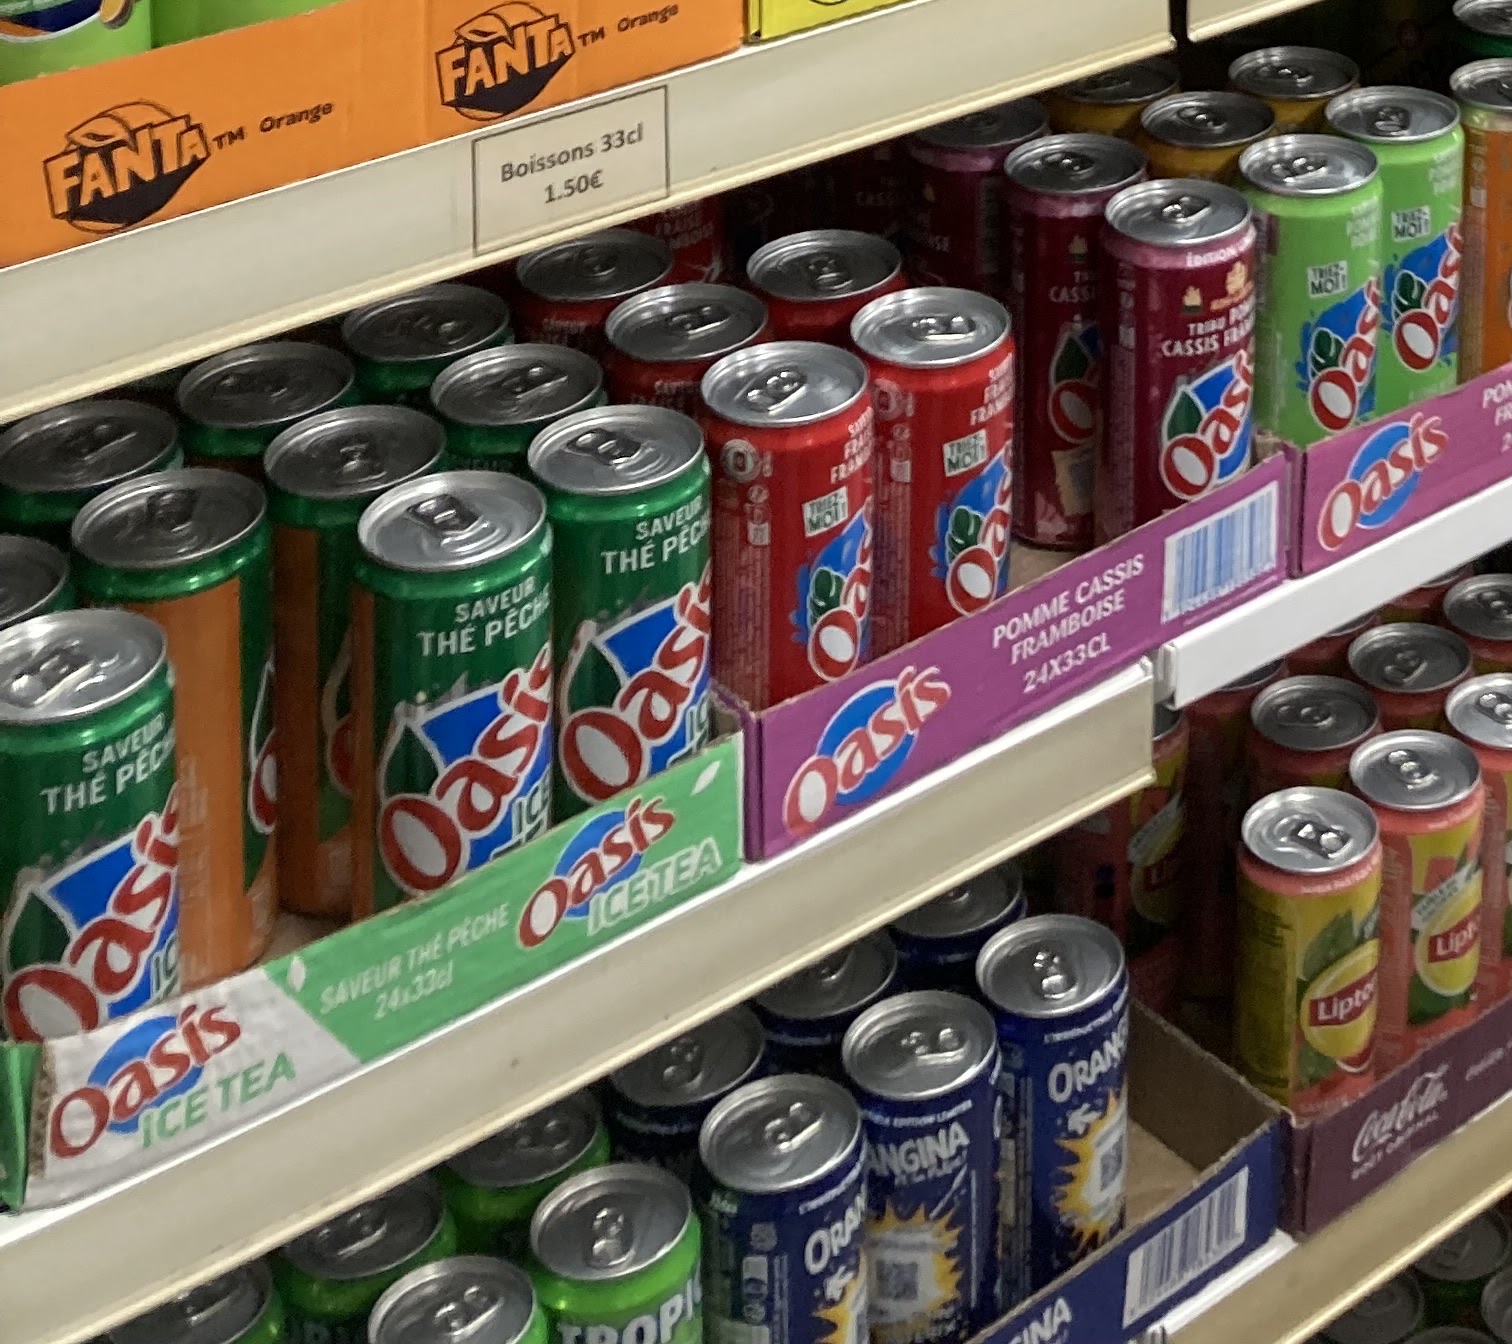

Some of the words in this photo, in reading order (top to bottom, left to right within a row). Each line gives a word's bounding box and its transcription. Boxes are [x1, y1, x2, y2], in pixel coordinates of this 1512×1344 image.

[435, 13, 577, 106] FANTA
[616, 0, 680, 33] Orange
[44, 116, 211, 220] FANTA
[259, 100, 335, 135] Orange
[500, 140, 595, 184] Boissons
[601, 122, 646, 155] 33cl
[543, 169, 606, 206] 1.50€
[1161, 337, 1220, 358] CASSIS
[1317, 411, 1450, 552] Oasis
[635, 494, 704, 542] SAVEUR
[601, 540, 655, 575] THÉ
[454, 575, 537, 625] SAVEUR
[991, 588, 1070, 649] POMME
[1075, 554, 1145, 604] CASSIS
[1010, 591, 1126, 666] FRAMBOISE
[417, 618, 477, 657] THÉ
[1021, 633, 1111, 694] 24X33CL
[81, 713, 165, 774] SAVEUR
[781, 664, 952, 840] Oasis
[40, 774, 107, 816] THÉ
[515, 794, 679, 952] Oasis
[3, 778, 180, 1041] Oasi
[318, 955, 404, 1014] SAVEUR
[404, 937, 443, 975] THÉ
[444, 904, 512, 959] PÊCHE
[1433, 921, 1481, 961] Lipt
[1312, 975, 1377, 1027] Lipto
[48, 1002, 243, 1160] Oasis
[140, 1096, 210, 1149] ICE
[218, 1050, 297, 1112] TEA
